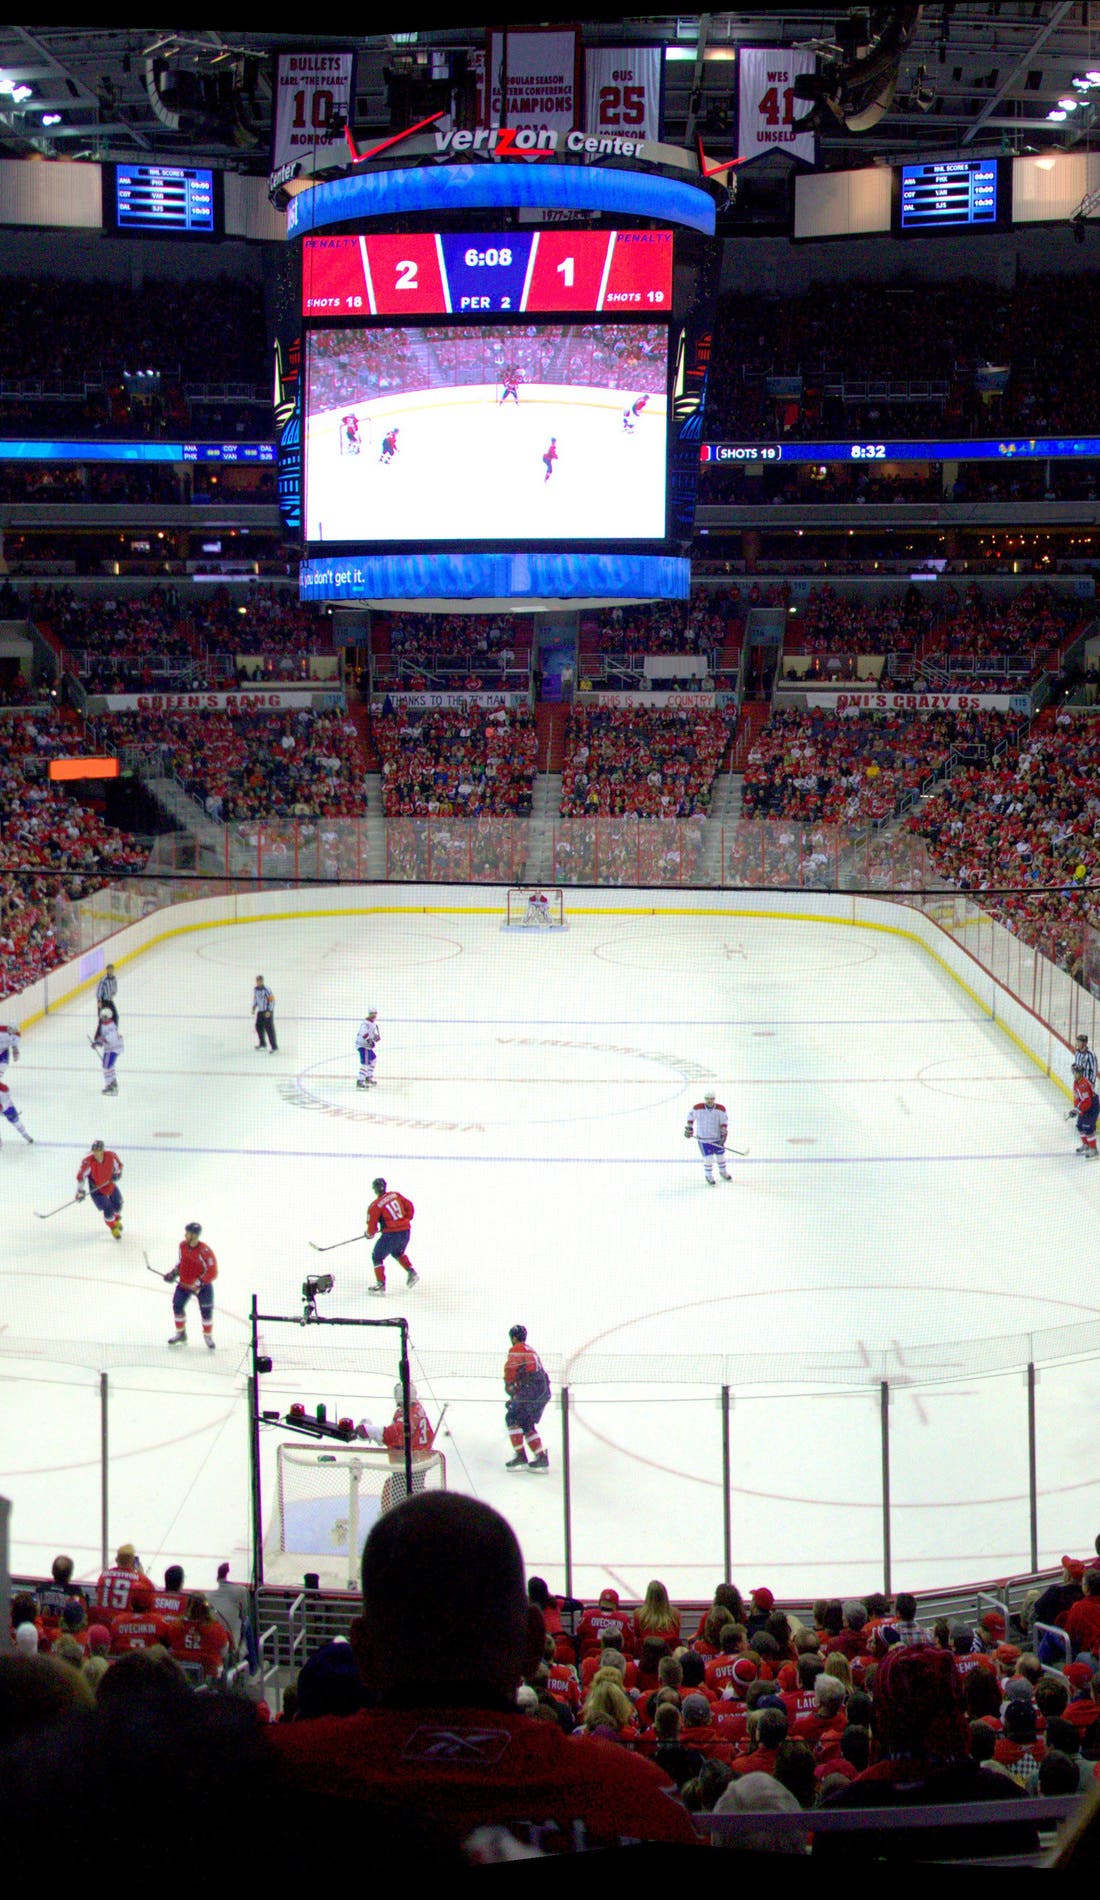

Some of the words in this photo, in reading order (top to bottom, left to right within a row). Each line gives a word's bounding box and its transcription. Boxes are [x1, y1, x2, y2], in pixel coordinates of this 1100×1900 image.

[289, 57, 341, 71] BULLETS
[280, 76, 299, 86] EARL
[535, 75, 564, 84] SEASON
[612, 70, 634, 82] GUS
[767, 71, 789, 83] WES
[492, 86, 524, 96] EATERN
[525, 85, 572, 95] CONFERENCE
[292, 90, 334, 128] 10
[600, 86, 645, 125] 25
[758, 87, 796, 126] 41
[756, 131, 797, 142] UNSELD
[434, 128, 558, 155] verizon
[567, 131, 645, 158] Center
[305, 239, 358, 249] PENALTY
[616, 233, 672, 243] PENALTY
[464, 248, 513, 267] 6:08
[394, 260, 419, 290] 2
[556, 257, 575, 287] 1
[306, 298, 341, 307] SHOTS
[345, 296, 363, 308] 18
[606, 292, 642, 302] SHOTS
[646, 291, 665, 302] 19
[460, 297, 491, 309] PER
[500, 297, 511, 309] 2
[720, 448, 759, 459] SHOTS
[761, 447, 776, 459] 19
[851, 445, 886, 458] 8:32
[313, 569, 333, 585] don't
[334, 570, 351, 587] get
[390, 695, 425, 706] THANKS
[430, 695, 443, 706] TO
[447, 695, 463, 706] THE
[487, 695, 506, 706] MAN
[602, 695, 621, 706] THIS
[625, 695, 634, 706] IS
[667, 695, 713, 706] COUNTRY
[837, 694, 887, 708] OVI'S
[893, 695, 951, 709] CRAZY
[384, 1199, 404, 1221] 19
[101, 1578, 131, 1610] 19
[154, 1597, 182, 1611] SEMIN
[118, 1623, 157, 1635] OVECHKIN
[715, 1666, 733, 1679] OVE
